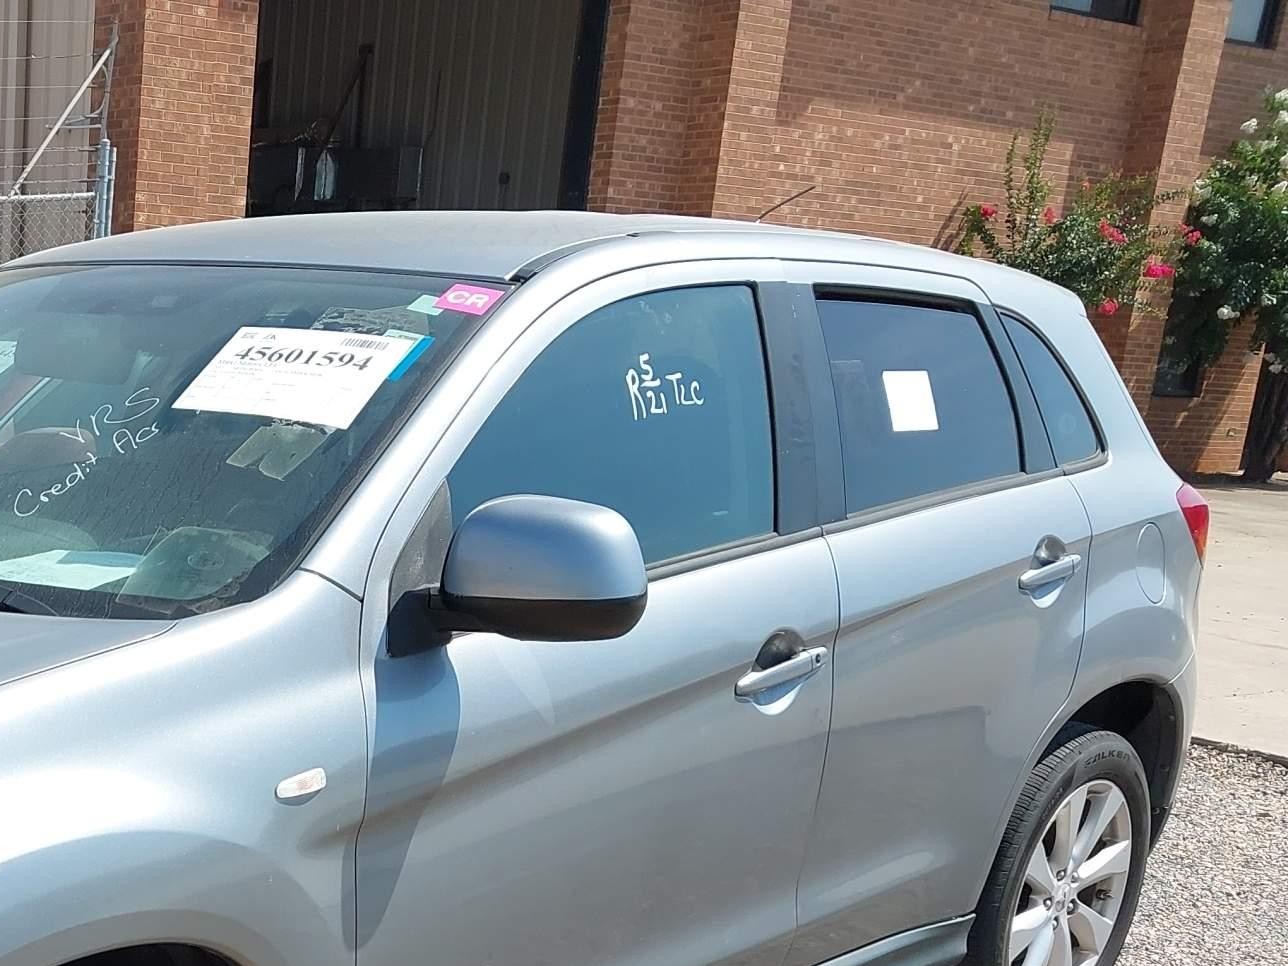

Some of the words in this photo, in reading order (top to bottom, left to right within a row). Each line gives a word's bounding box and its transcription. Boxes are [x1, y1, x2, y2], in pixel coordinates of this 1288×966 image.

[446, 290, 490, 308] CR
[234, 345, 375, 371] 45601594
[13, 452, 99, 517] Credit
